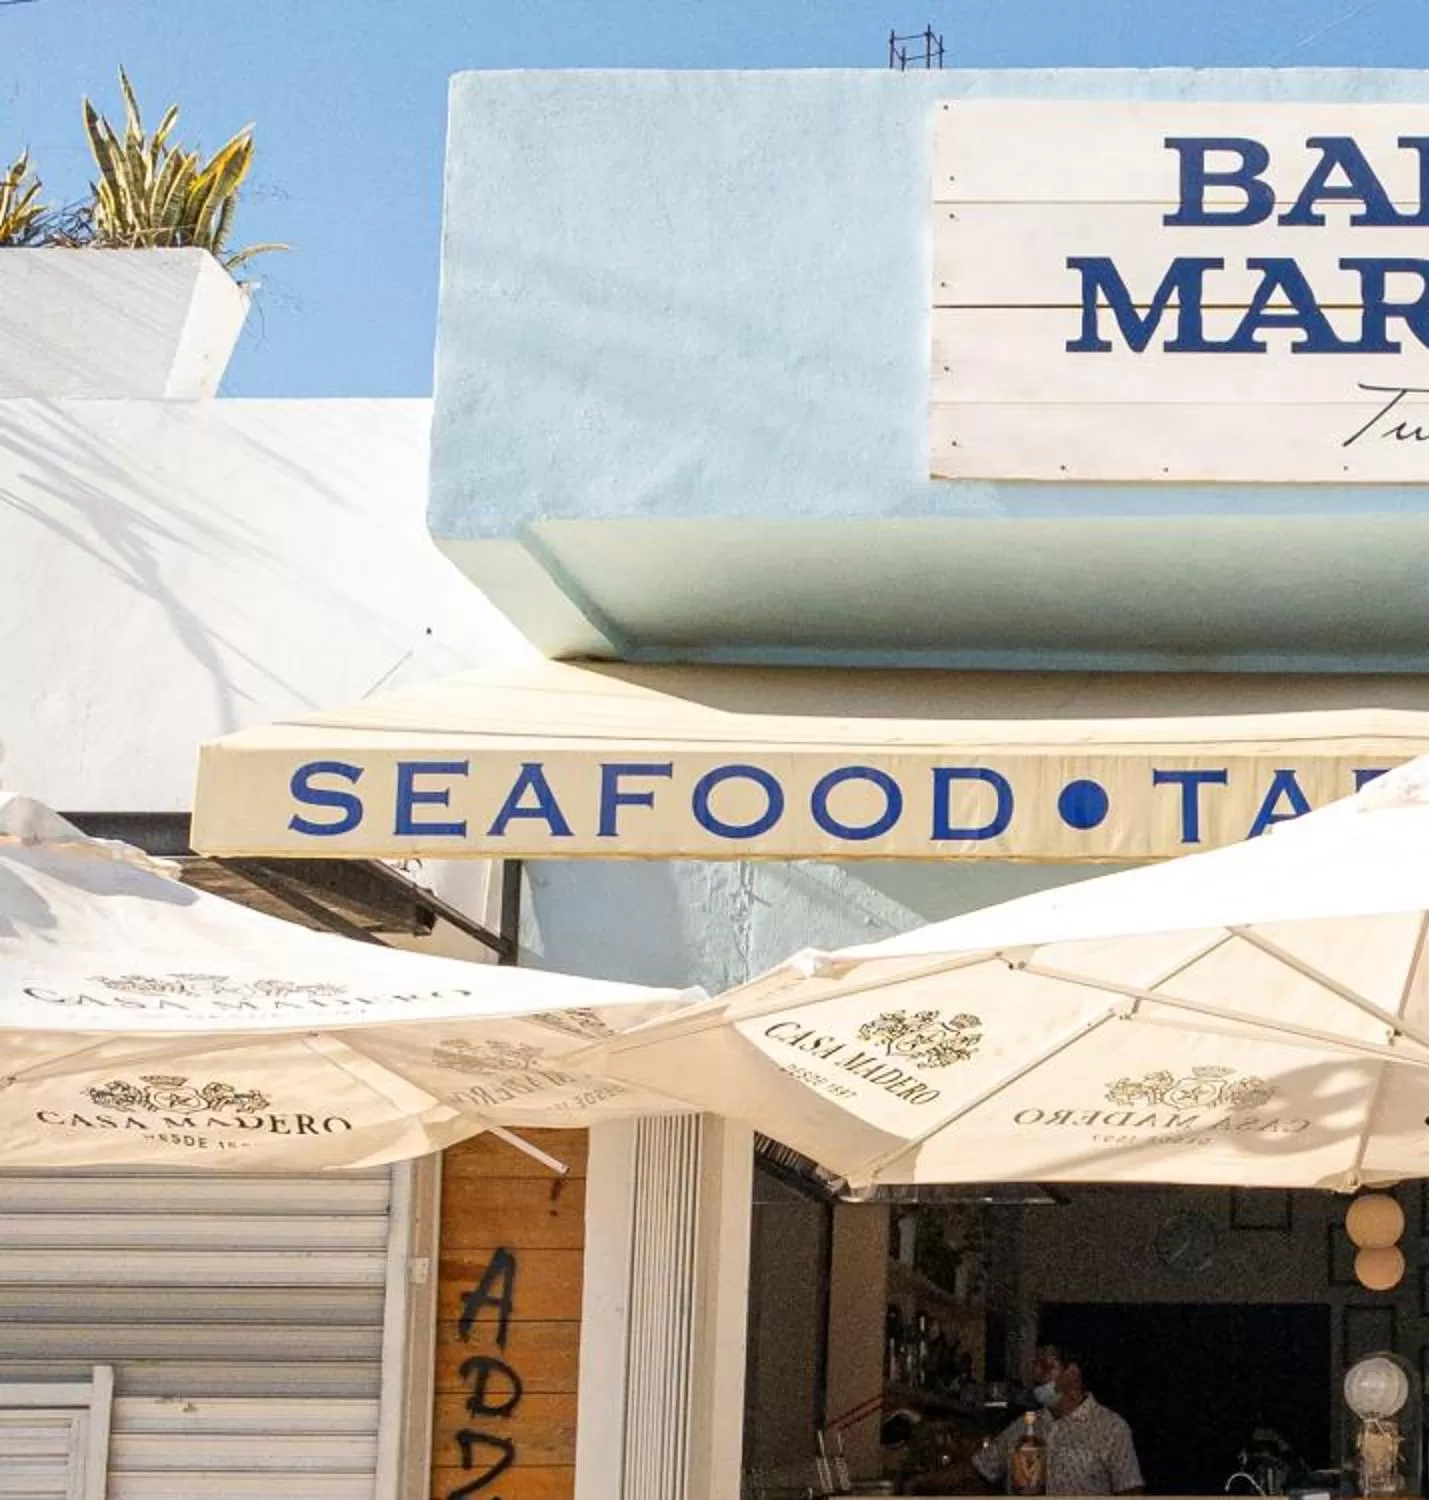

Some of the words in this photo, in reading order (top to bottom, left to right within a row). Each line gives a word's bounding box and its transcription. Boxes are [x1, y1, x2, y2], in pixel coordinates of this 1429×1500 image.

[289, 761, 1014, 840] SEAFOOD
[764, 1020, 848, 1060] CASA
[835, 1050, 942, 1106] MADERO
[35, 1110, 146, 1131] CASA
[163, 1113, 353, 1135] MADERO
